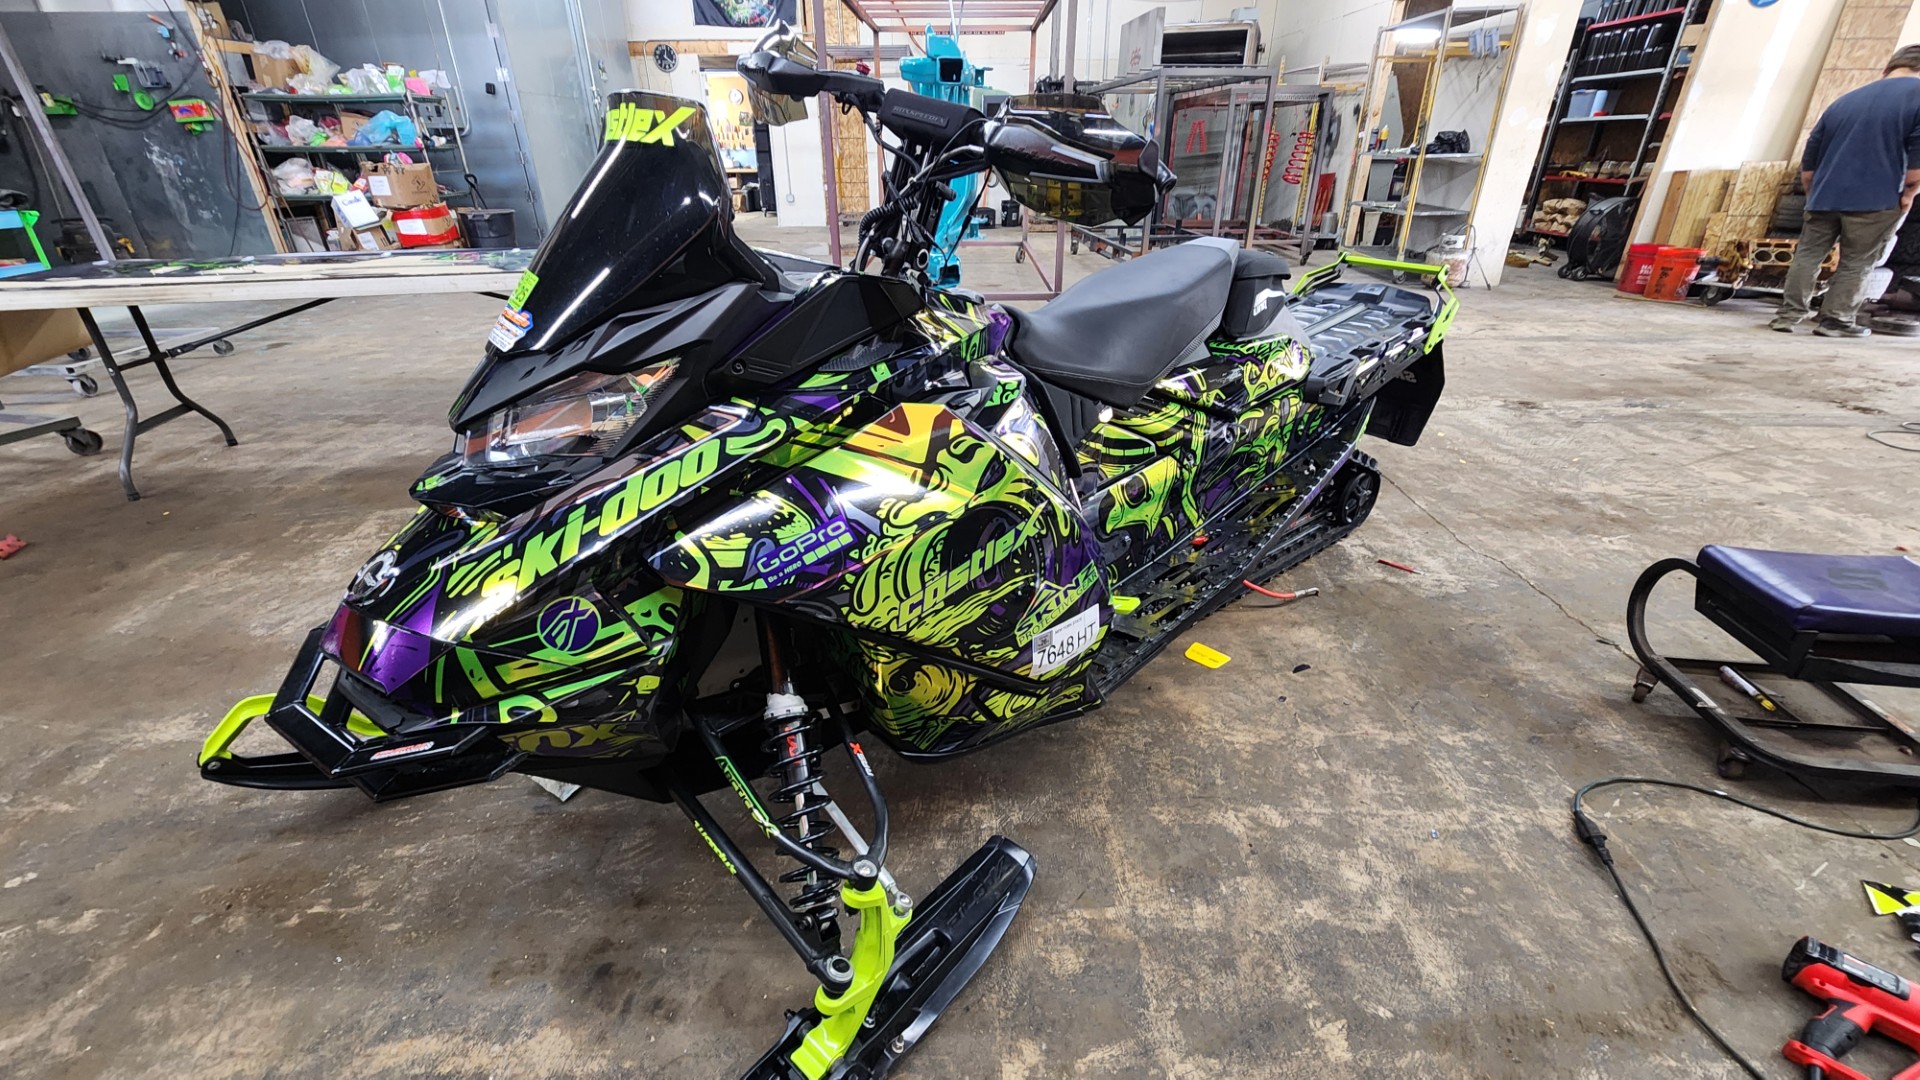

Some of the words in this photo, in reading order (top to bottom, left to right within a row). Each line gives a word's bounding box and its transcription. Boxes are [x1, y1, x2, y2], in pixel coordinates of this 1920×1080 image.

[756, 520, 847, 574] GoPro
[767, 573, 778, 583] Be
[783, 560, 803, 575] HERO
[1016, 564, 1094, 635] SKINZ
[1018, 594, 1076, 646] PROTECTIVE
[1075, 572, 1099, 596] GEAR
[1036, 634, 1075, 669] 7648
[1076, 621, 1097, 650] HT
